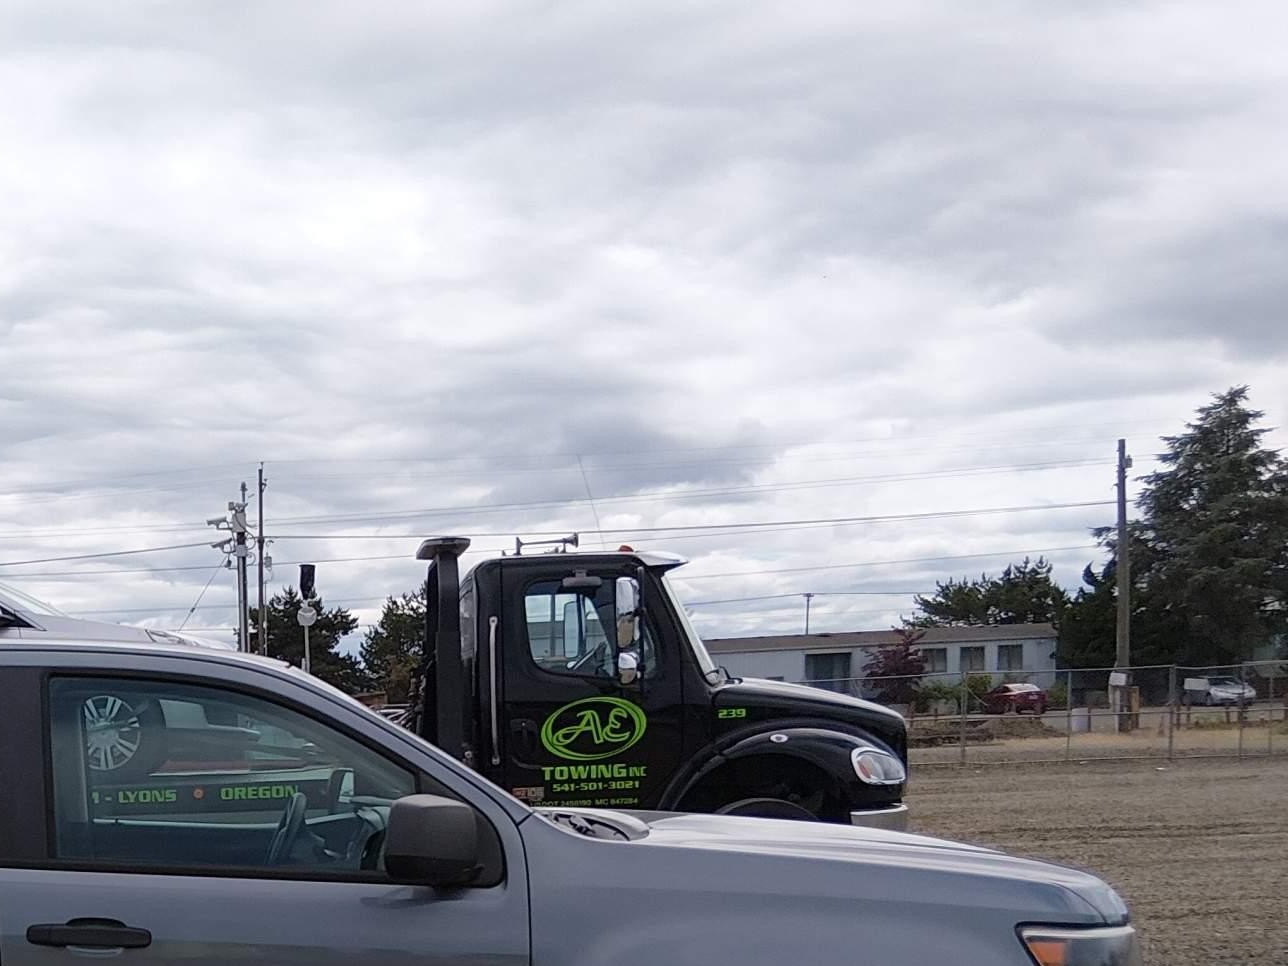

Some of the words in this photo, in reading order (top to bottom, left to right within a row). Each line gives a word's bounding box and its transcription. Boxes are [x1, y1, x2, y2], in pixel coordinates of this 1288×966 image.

[717, 708, 747, 719] 239
[541, 763, 627, 781] TOWING
[629, 765, 648, 778] INC
[552, 780, 640, 792] 541-501-3021
[118, 789, 177, 804] LYONS
[220, 785, 298, 800] OREGON
